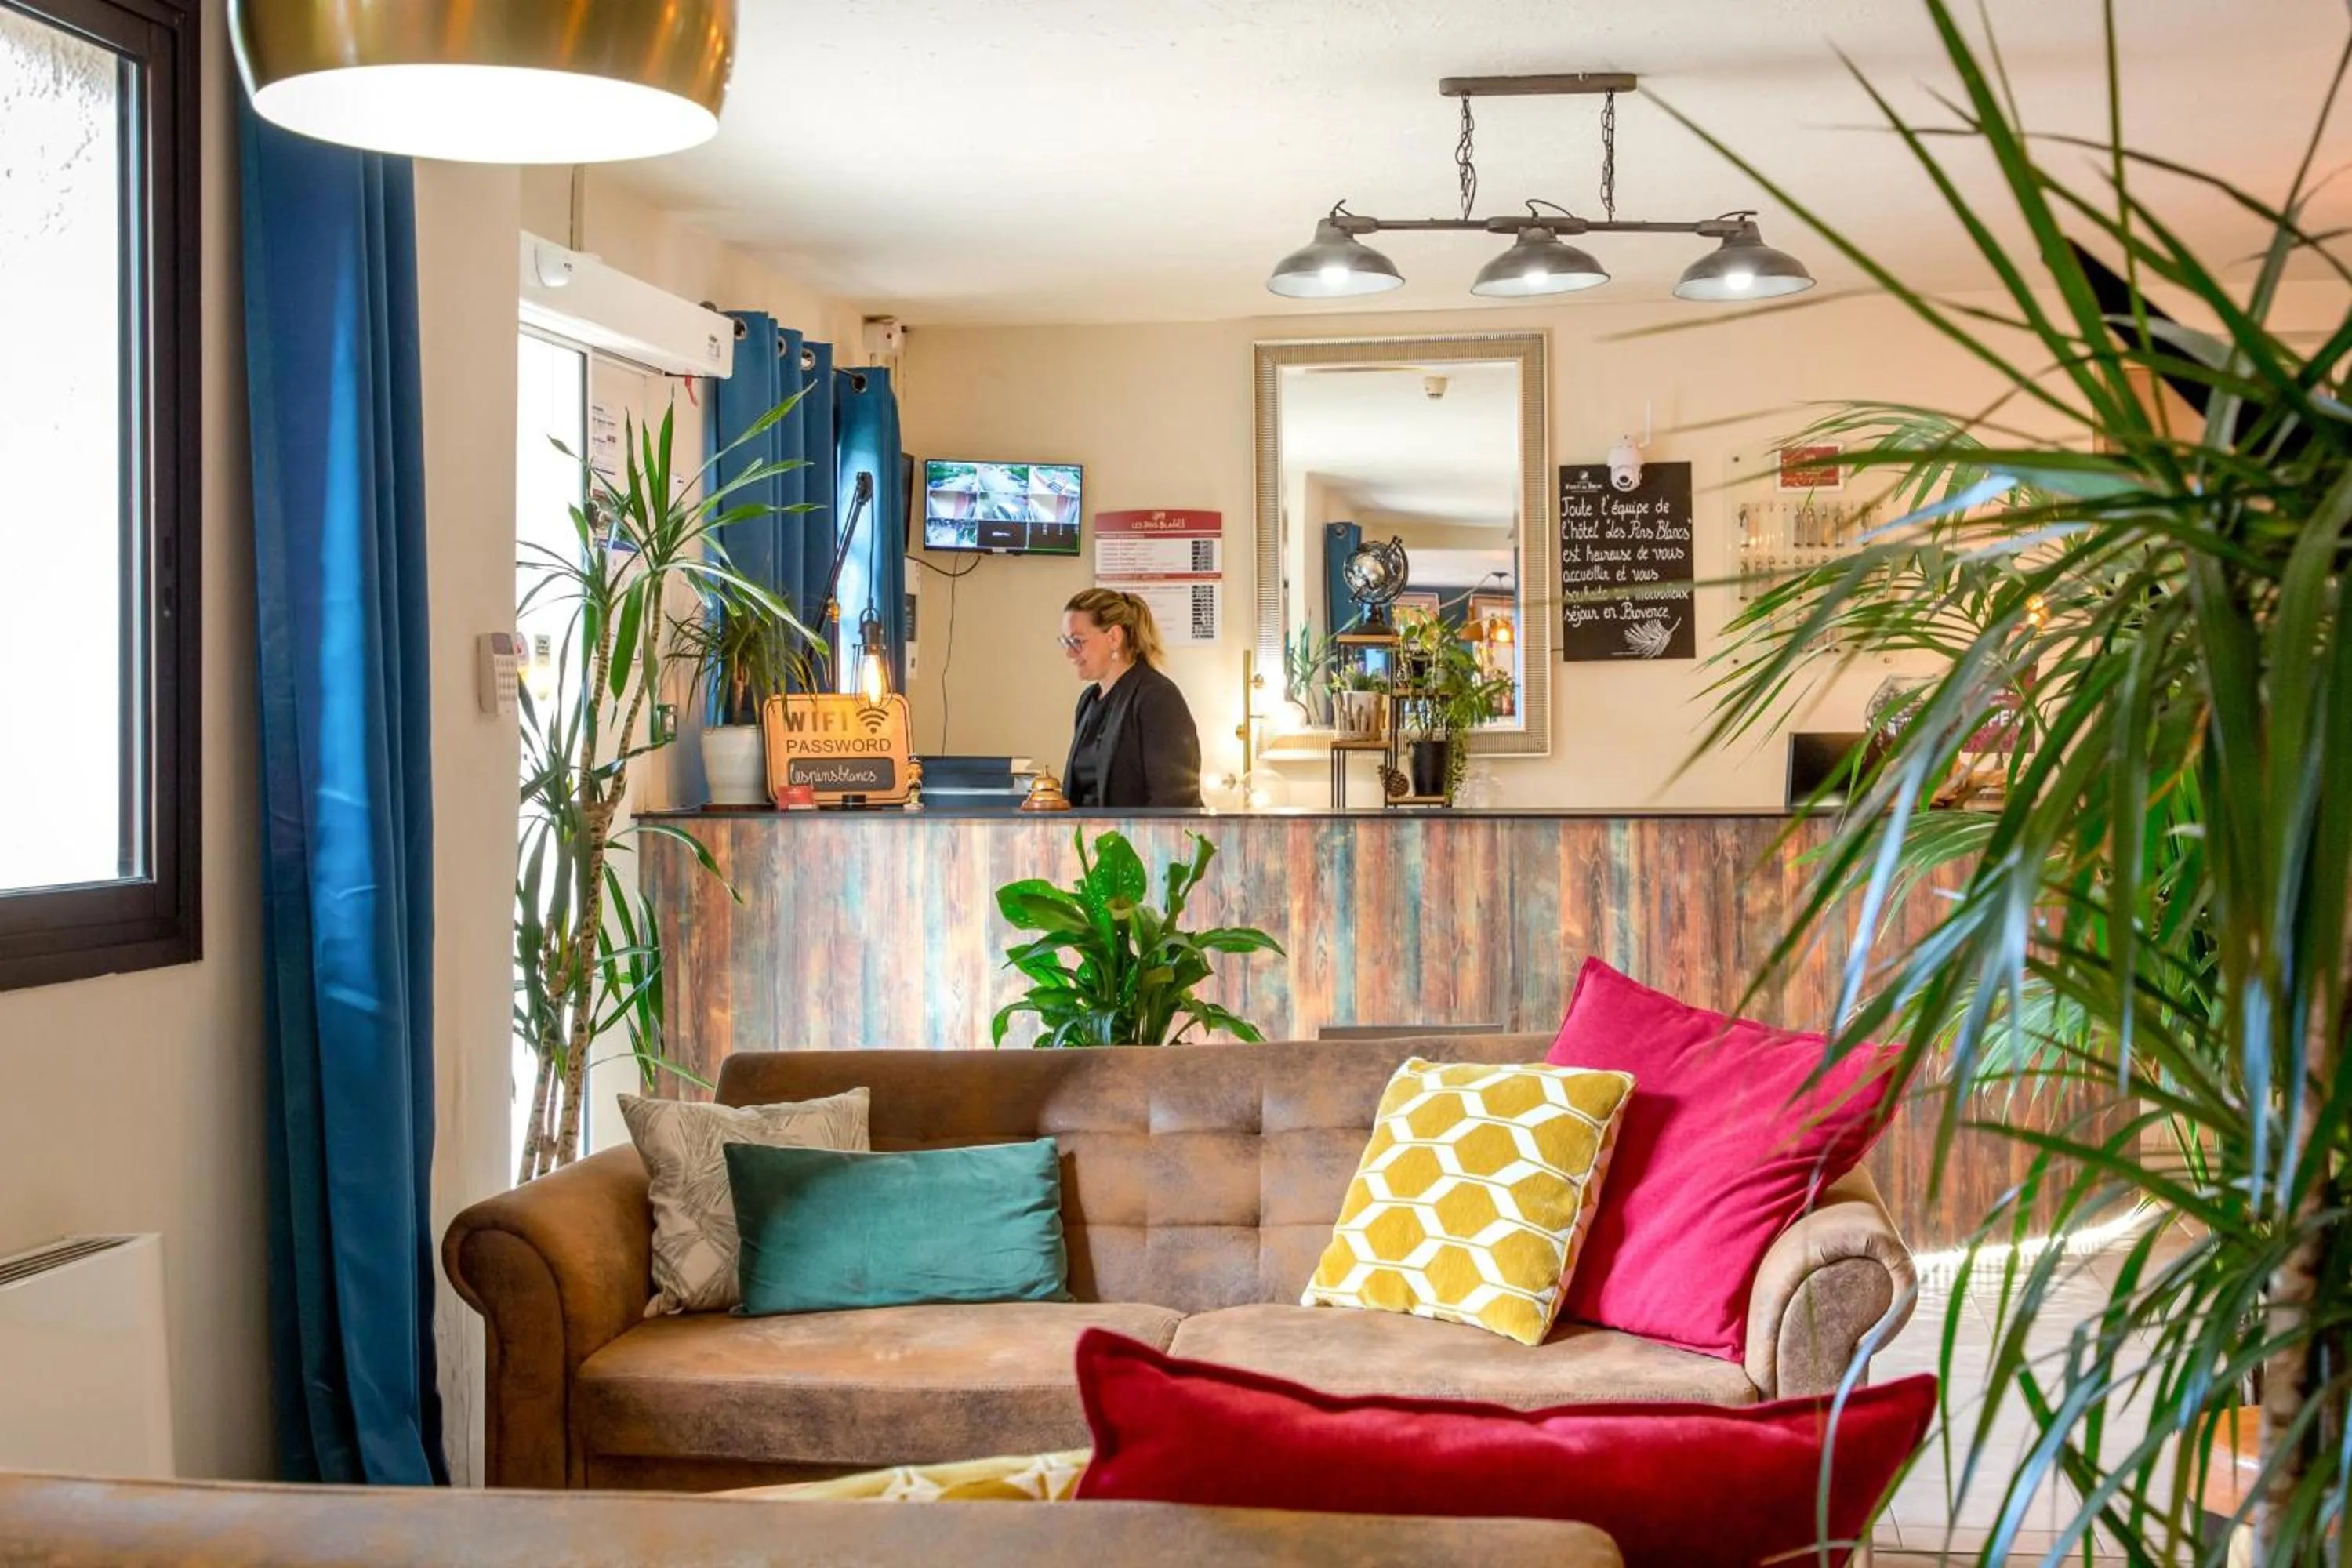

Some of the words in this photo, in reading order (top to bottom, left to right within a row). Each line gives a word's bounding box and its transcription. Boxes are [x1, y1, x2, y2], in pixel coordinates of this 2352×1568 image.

[1562, 496, 1592, 517] Toute
[1655, 496, 1670, 514] de
[1563, 544, 1581, 562] est
[1586, 544, 1632, 562] heureuse
[1636, 544, 1649, 560] de
[1653, 546, 1685, 560] vous
[1563, 564, 1610, 583] accueillir
[1616, 564, 1627, 581] et
[1632, 568, 1659, 581] vous
[1565, 605, 1599, 627] séjour
[1603, 607, 1617, 619] en
[786, 711, 848, 732] WIFI
[786, 738, 892, 753] PASSWORD
